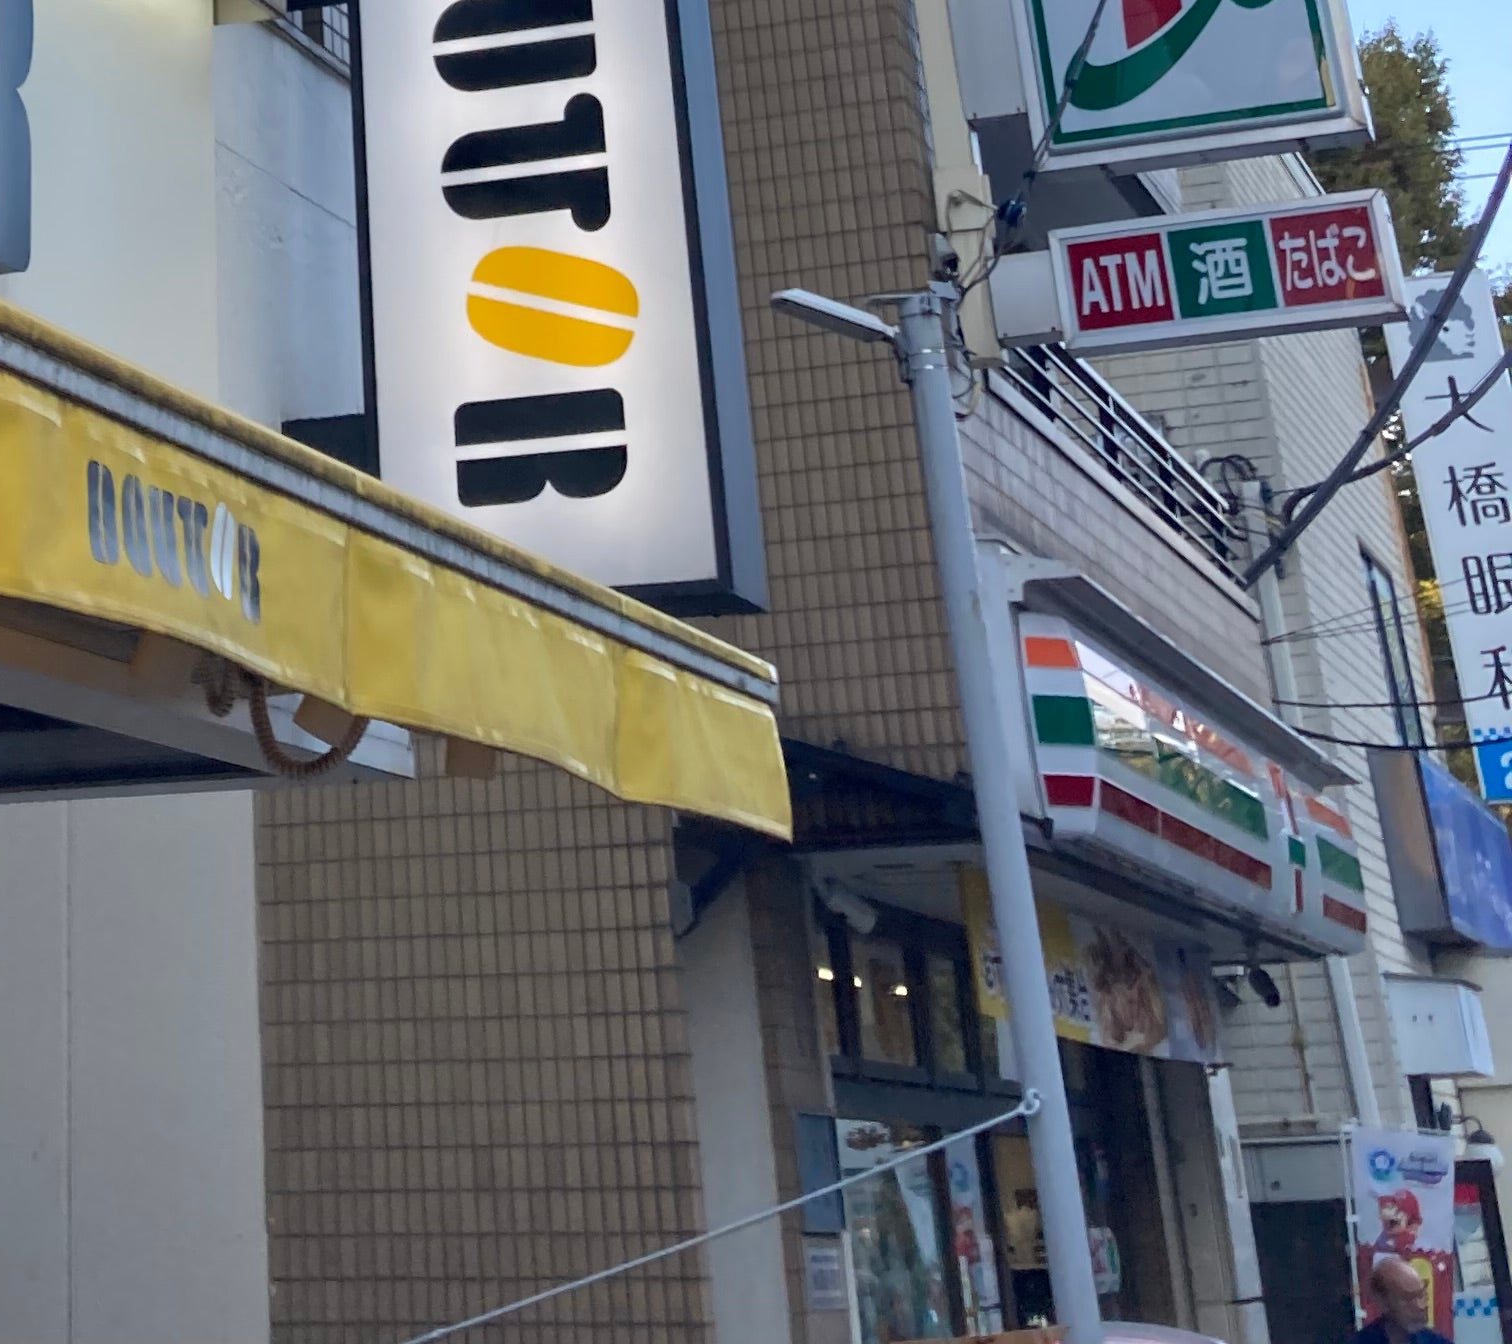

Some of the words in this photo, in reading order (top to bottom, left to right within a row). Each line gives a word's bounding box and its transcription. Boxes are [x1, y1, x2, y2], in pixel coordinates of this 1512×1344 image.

[1081, 249, 1165, 315] ATM
[1189, 238, 1253, 305] 酒
[1279, 224, 1376, 291] たばこ
[87, 460, 260, 626] DOUTOR
